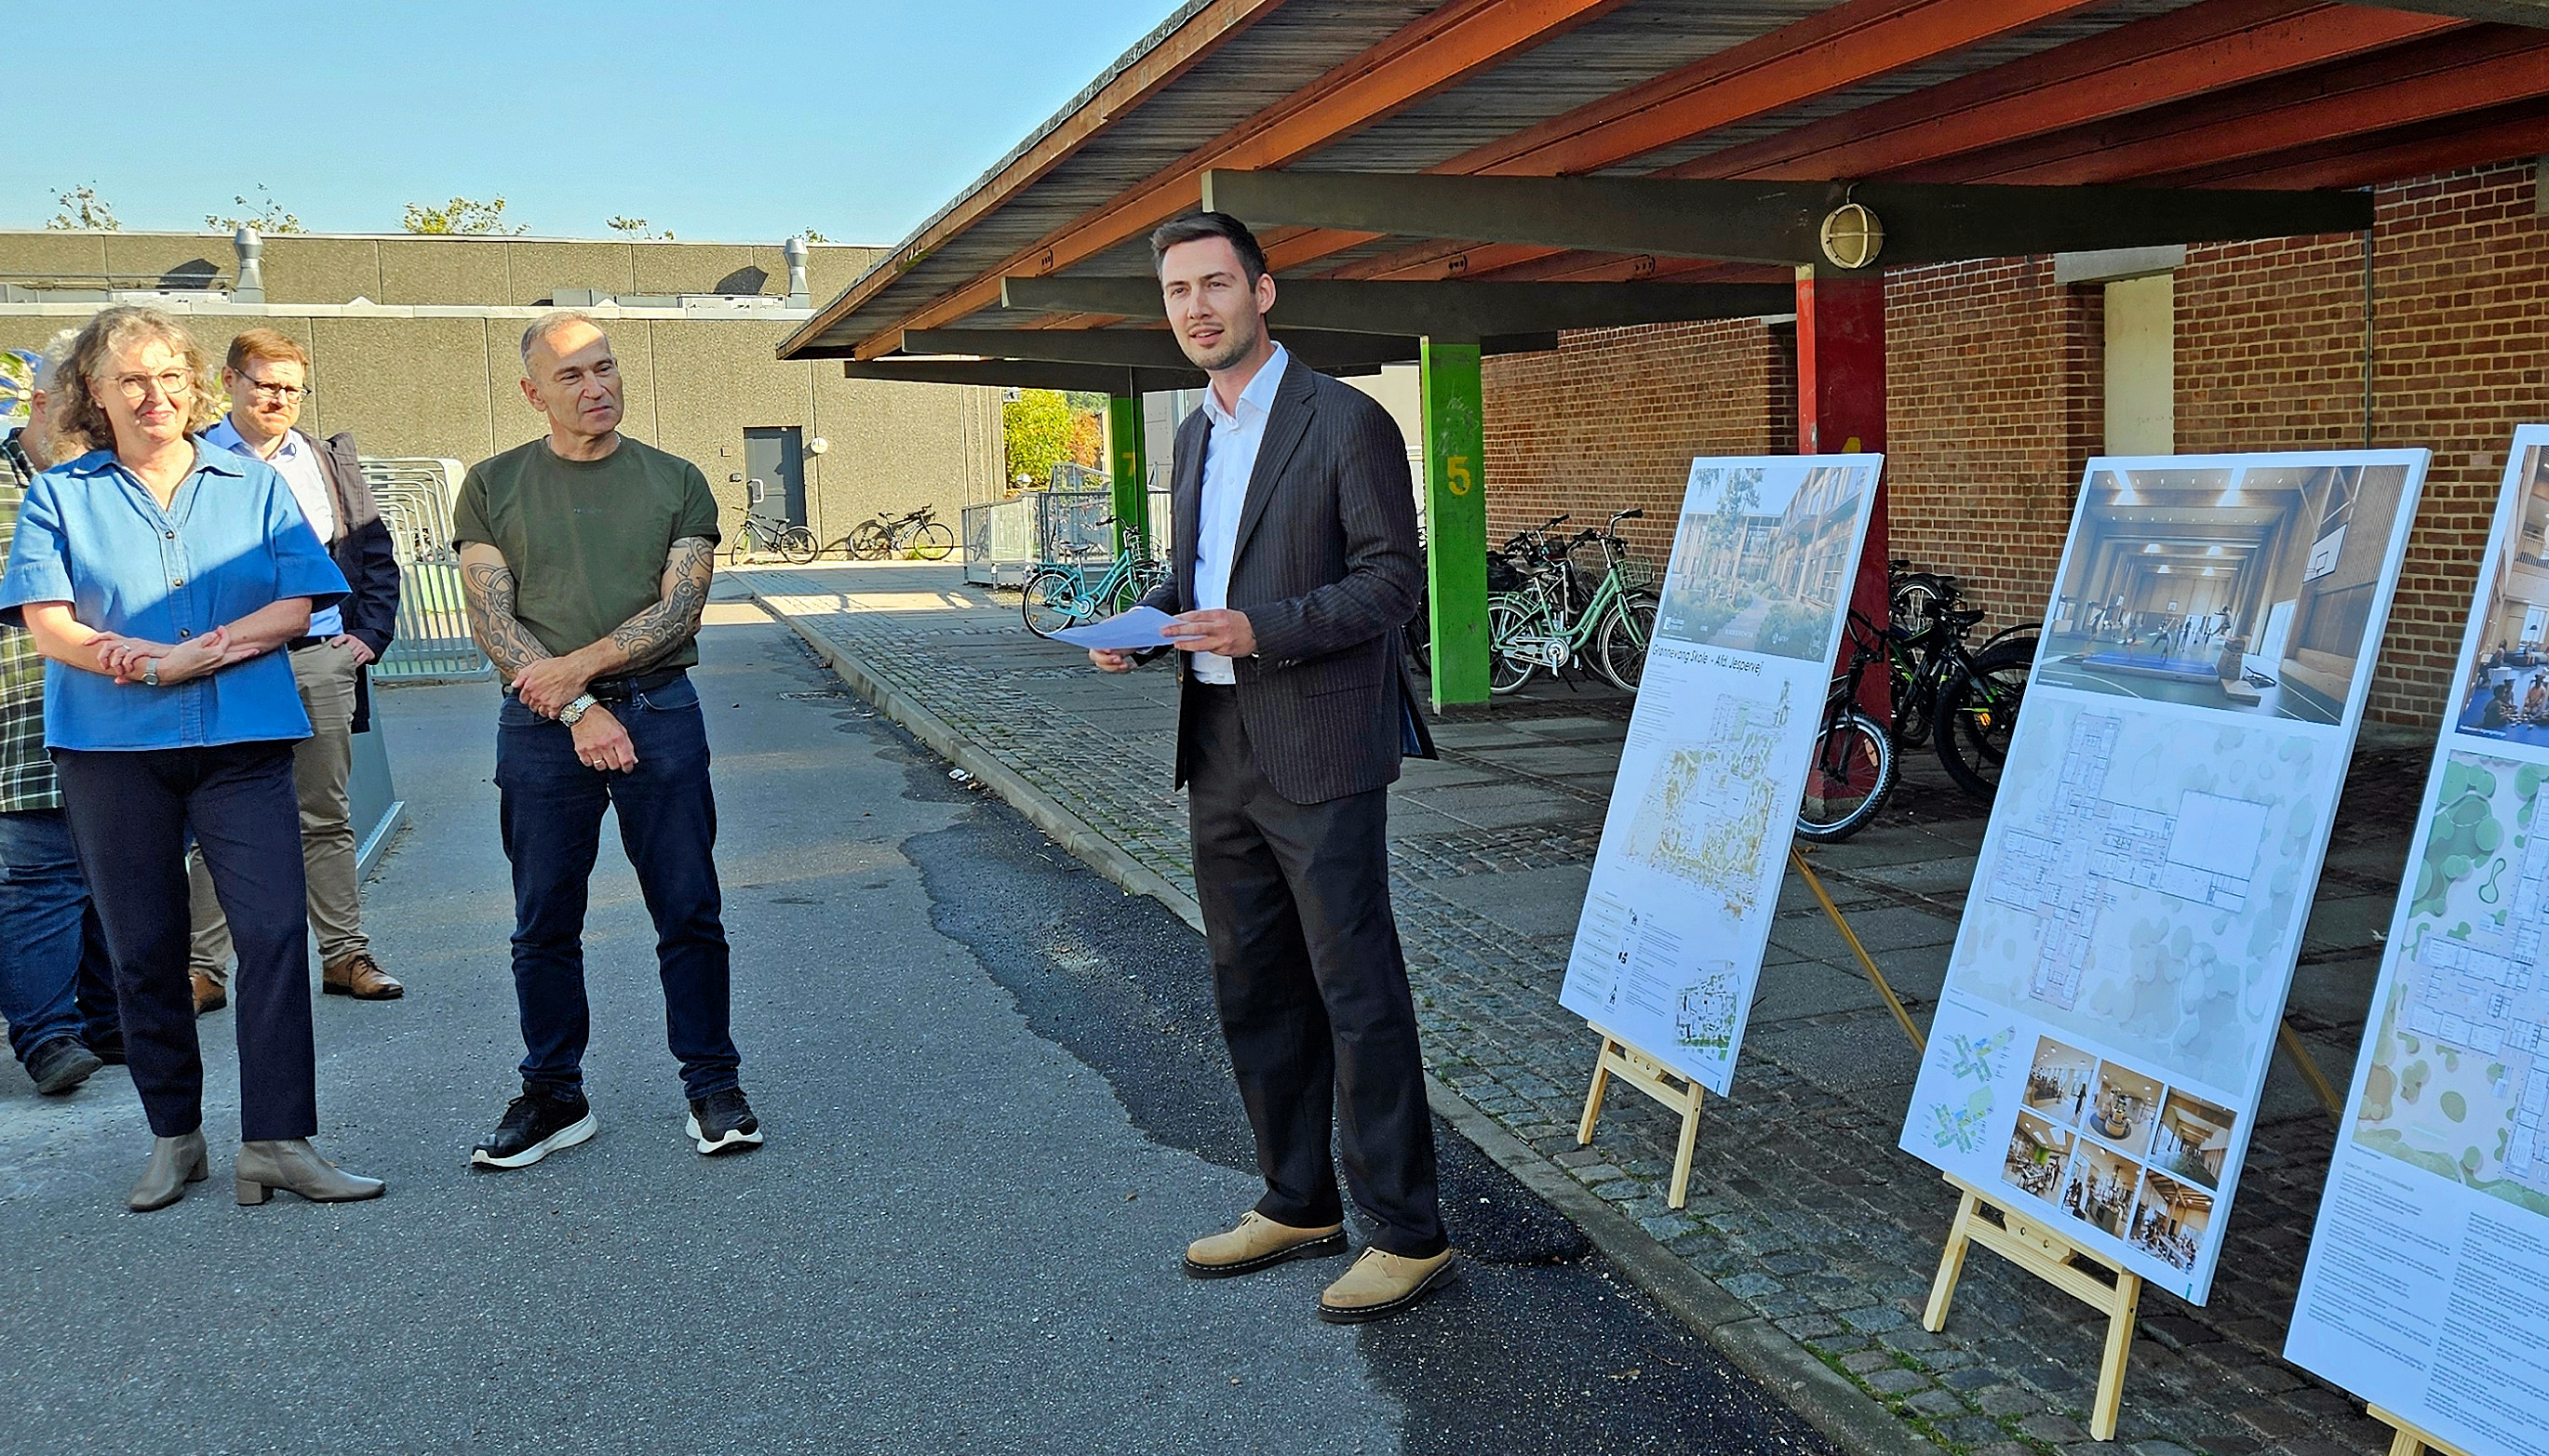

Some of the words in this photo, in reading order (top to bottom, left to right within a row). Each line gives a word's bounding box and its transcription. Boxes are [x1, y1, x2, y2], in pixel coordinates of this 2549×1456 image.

[1121, 452, 1135, 477] 7
[1447, 456, 1470, 496] 5
[1690, 649, 1709, 664] Skole
